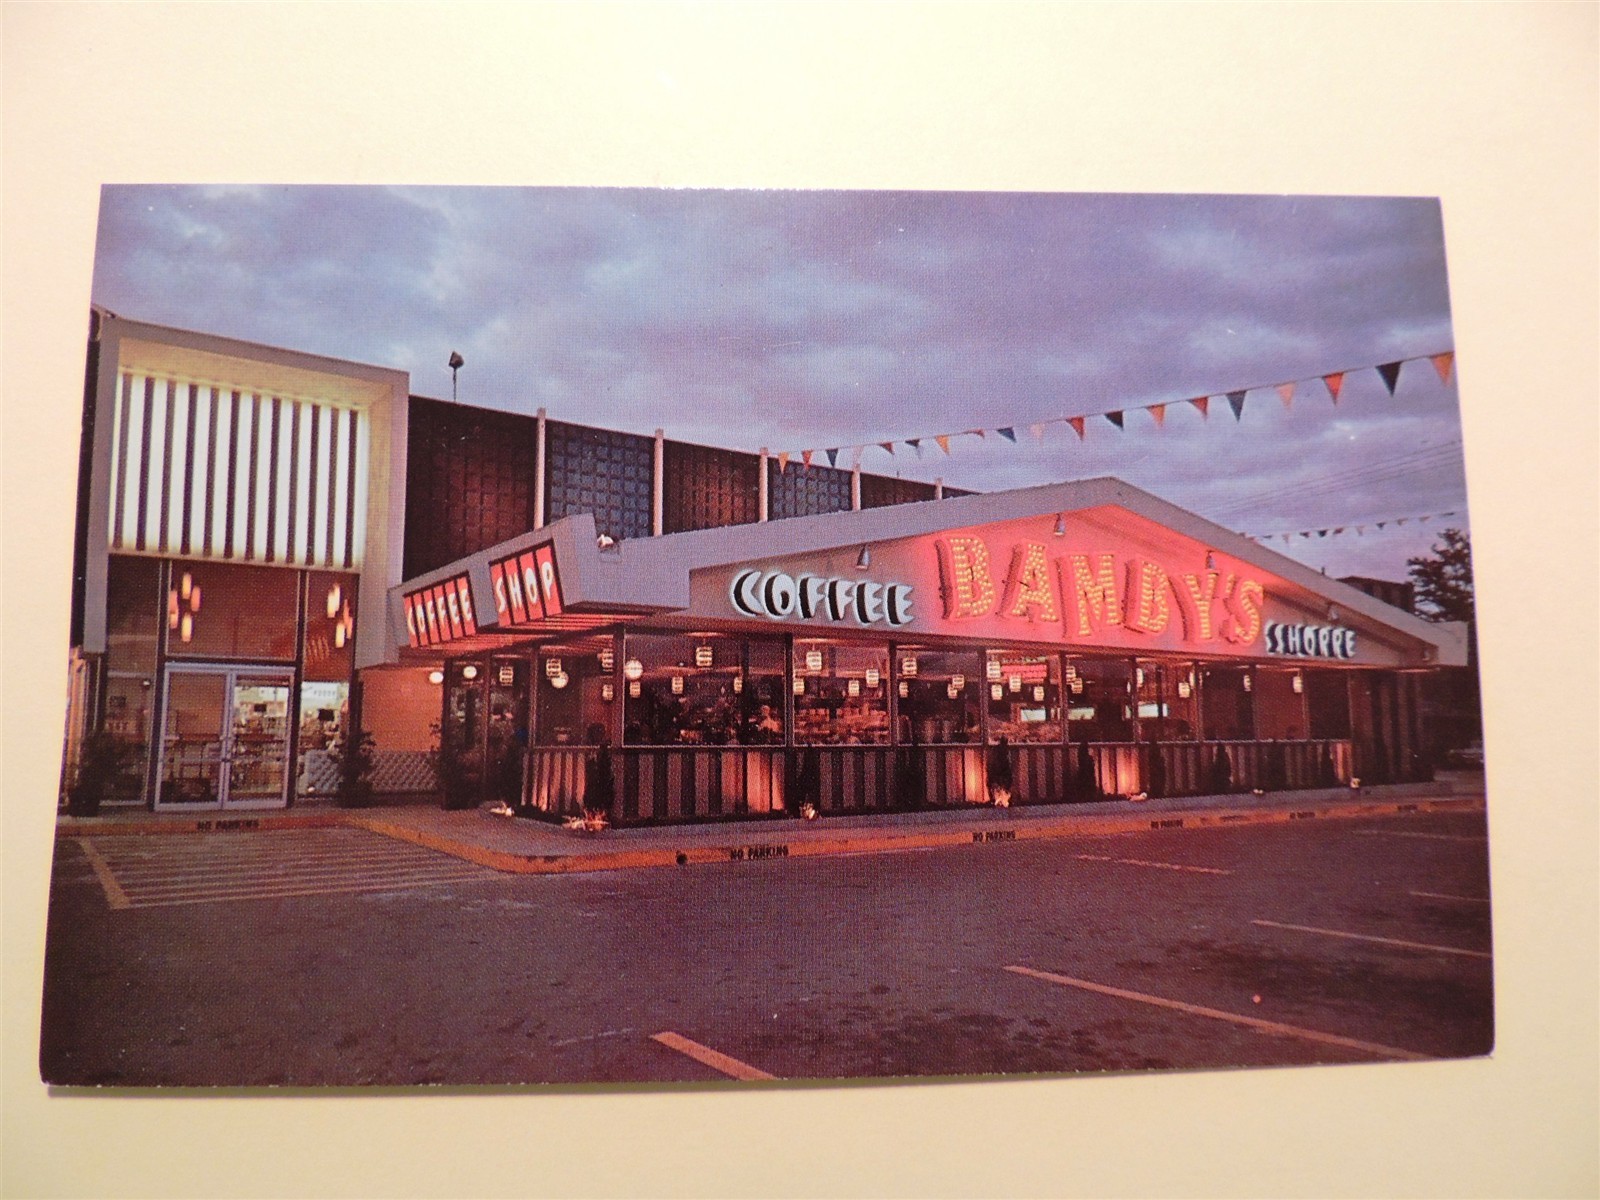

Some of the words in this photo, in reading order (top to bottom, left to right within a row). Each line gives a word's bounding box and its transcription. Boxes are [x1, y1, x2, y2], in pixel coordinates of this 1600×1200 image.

[406, 587, 473, 636] COFFEE
[494, 561, 556, 614] SHOP
[730, 569, 915, 626] COFFEE
[1264, 620, 1357, 659] SHOPPE
[730, 848, 744, 861] NO
[747, 843, 789, 860] PARKING
